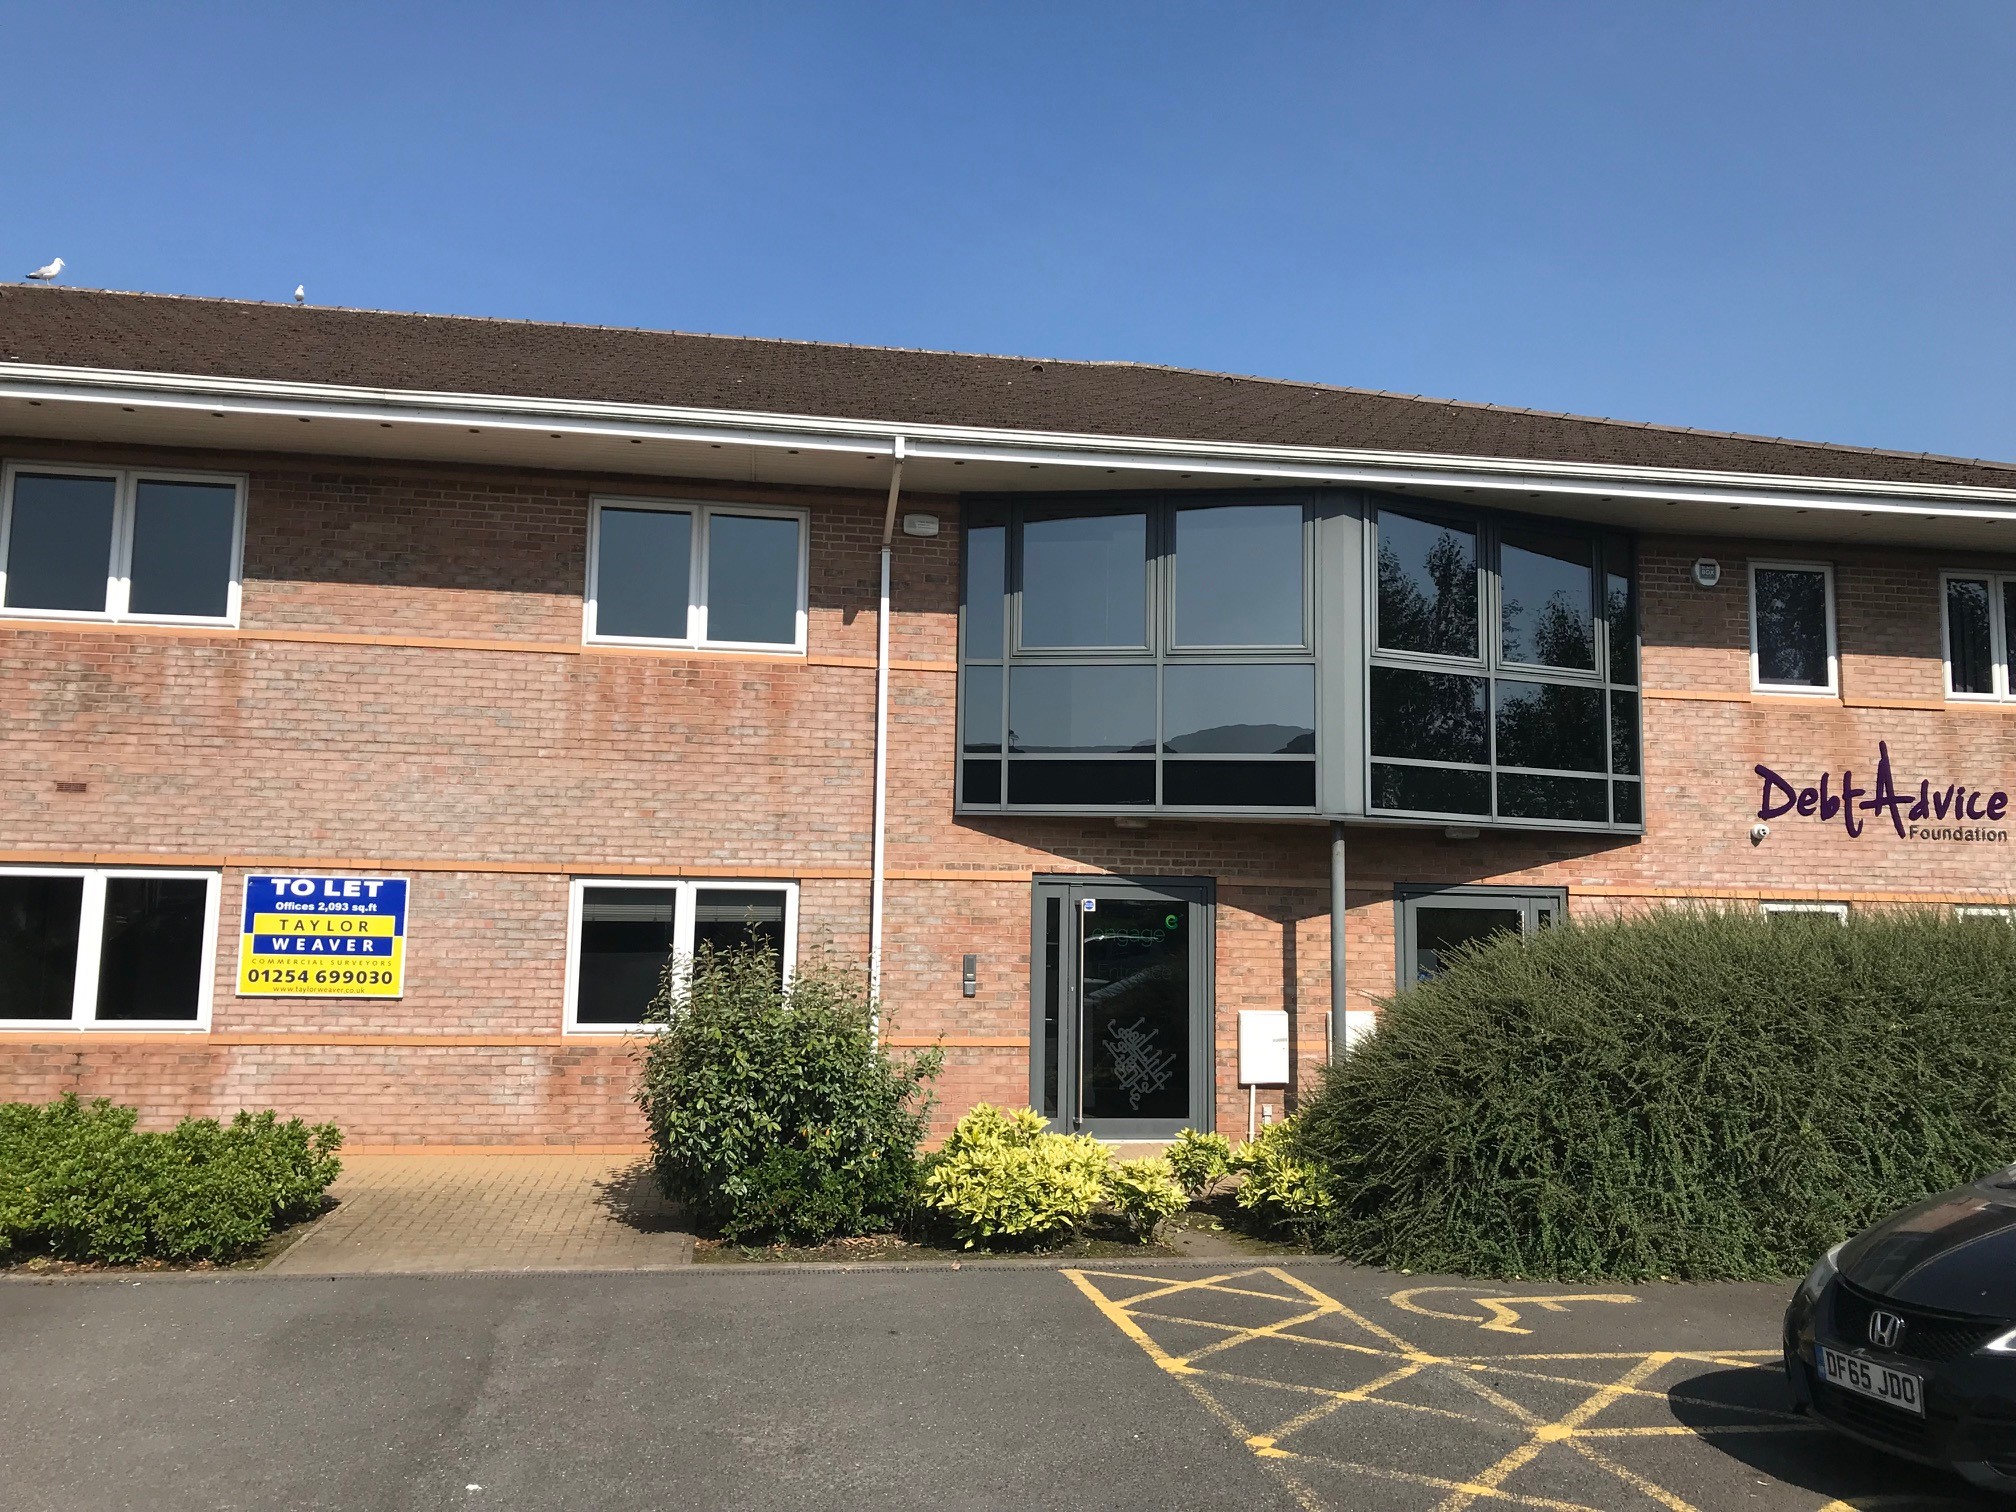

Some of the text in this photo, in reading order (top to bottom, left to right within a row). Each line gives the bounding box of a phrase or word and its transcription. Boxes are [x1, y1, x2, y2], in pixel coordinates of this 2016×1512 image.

[1909, 824, 2008, 843] Foundation
[271, 878, 384, 898] TO LET
[275, 901, 378, 914] Offices 2,093 sq.ft
[279, 919, 369, 933] TAYLOR
[272, 937, 374, 952] WEAVER
[1092, 928, 1165, 947] engage
[251, 958, 392, 967] COMMERCIAL SURVEYORS
[247, 969, 393, 984] 01254 699030
[1098, 962, 1173, 979] Entrce
[272, 985, 365, 995] www.taylorweaver.co.uk
[1826, 1351, 1872, 1390] DF65
